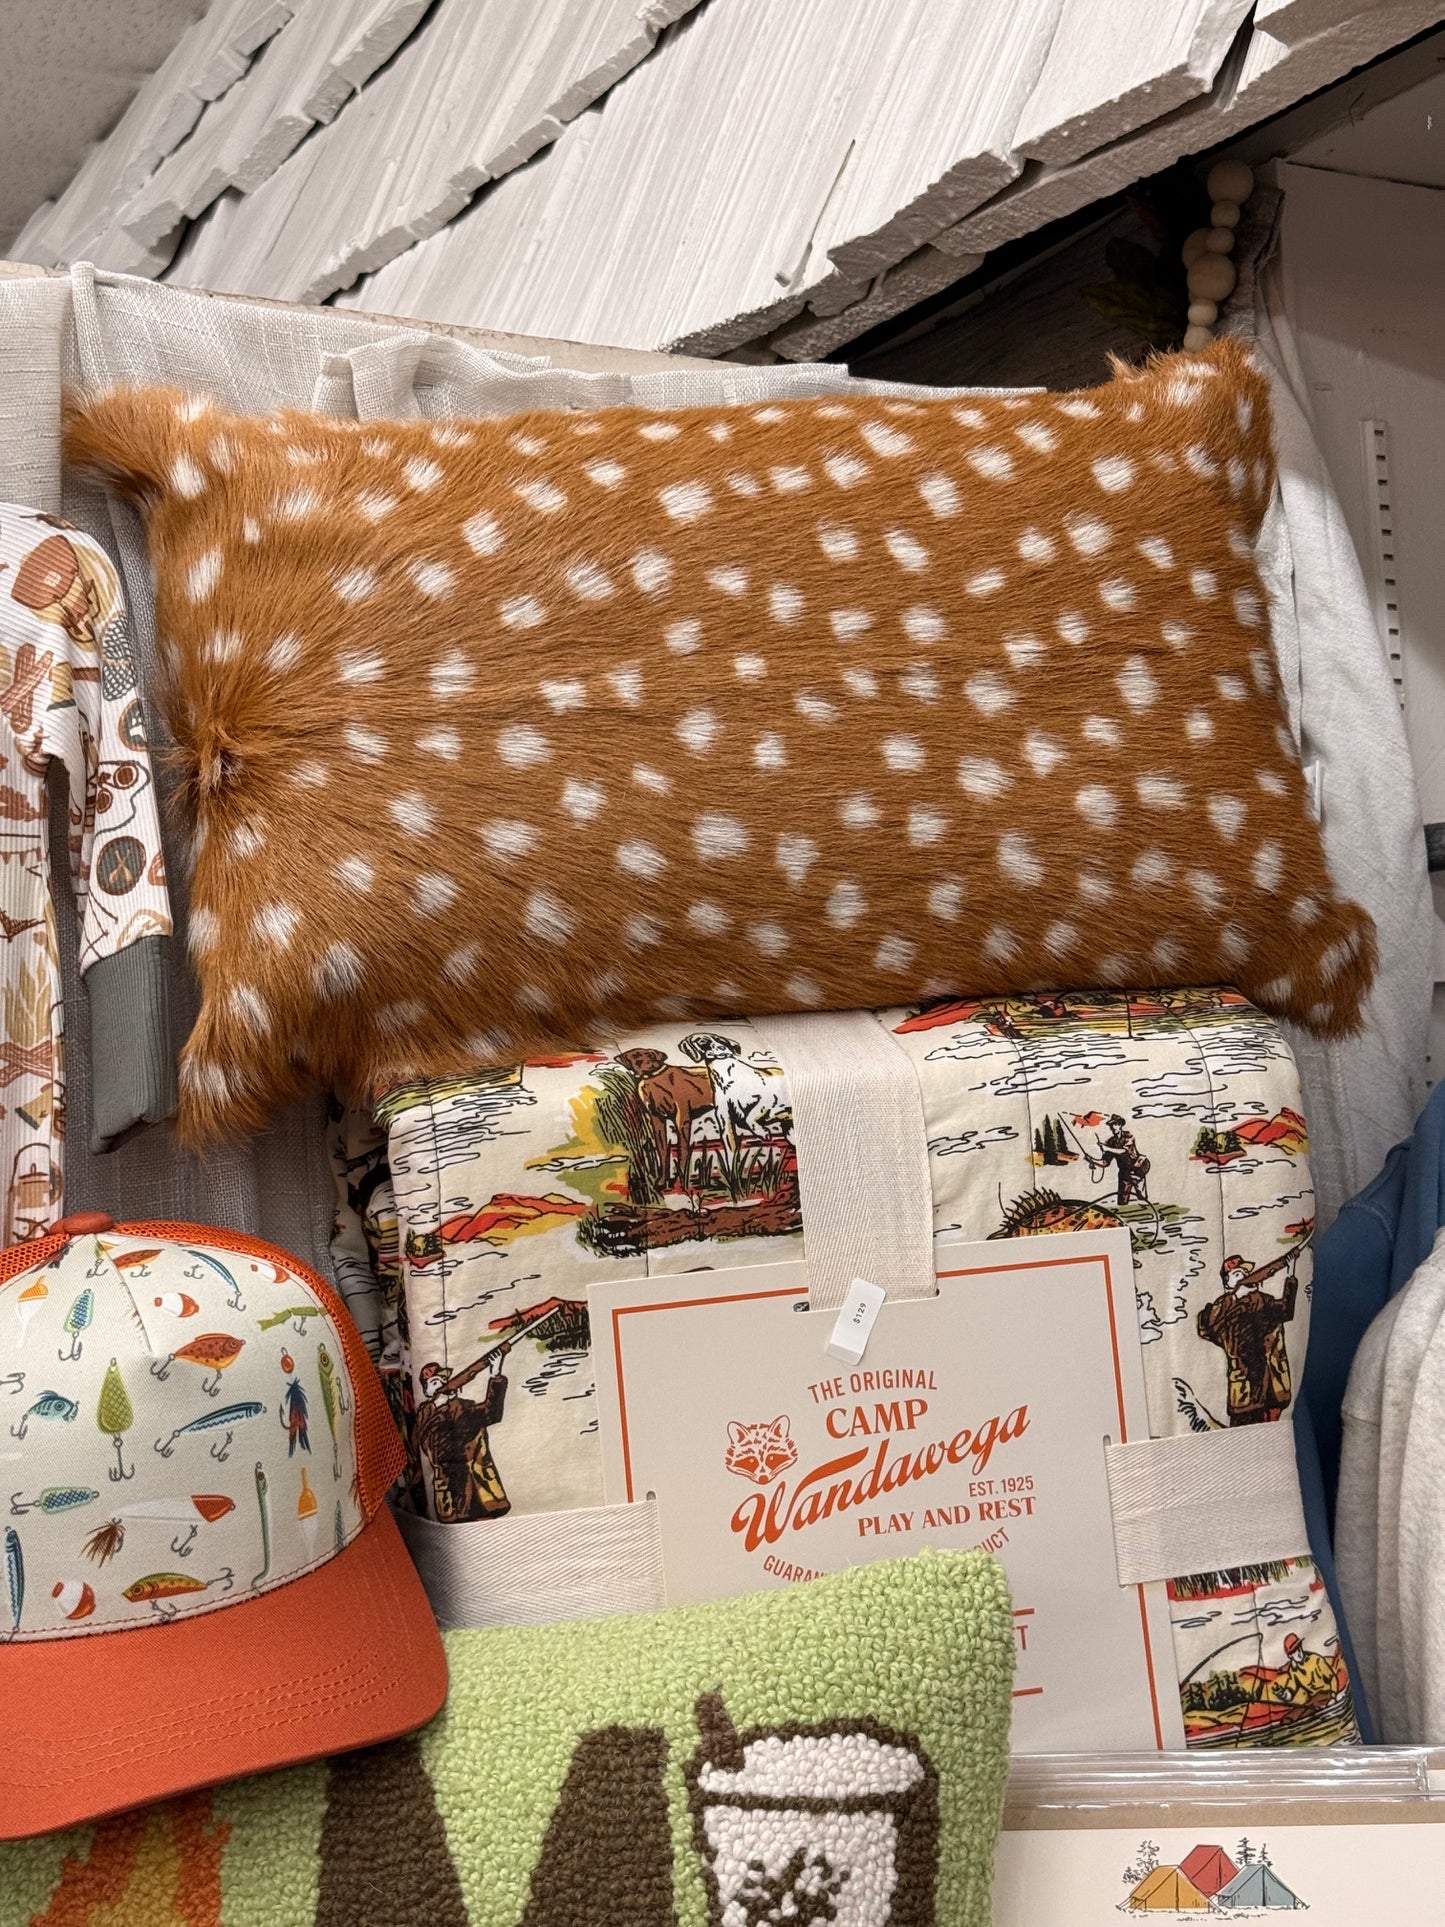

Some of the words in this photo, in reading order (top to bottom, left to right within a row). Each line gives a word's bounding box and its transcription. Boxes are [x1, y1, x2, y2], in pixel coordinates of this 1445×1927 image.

[852, 1302, 867, 1325] $129
[807, 1376, 846, 1405] THE
[849, 1368, 938, 1394] ORIGINAL
[825, 1398, 929, 1439] CAMP
[730, 1404, 1031, 1552] Wandawega
[968, 1480, 999, 1498] EST.
[1000, 1475, 1034, 1494] 1925
[857, 1511, 915, 1537] PLAY
[922, 1504, 971, 1529] AND
[978, 1496, 1038, 1522] REST
